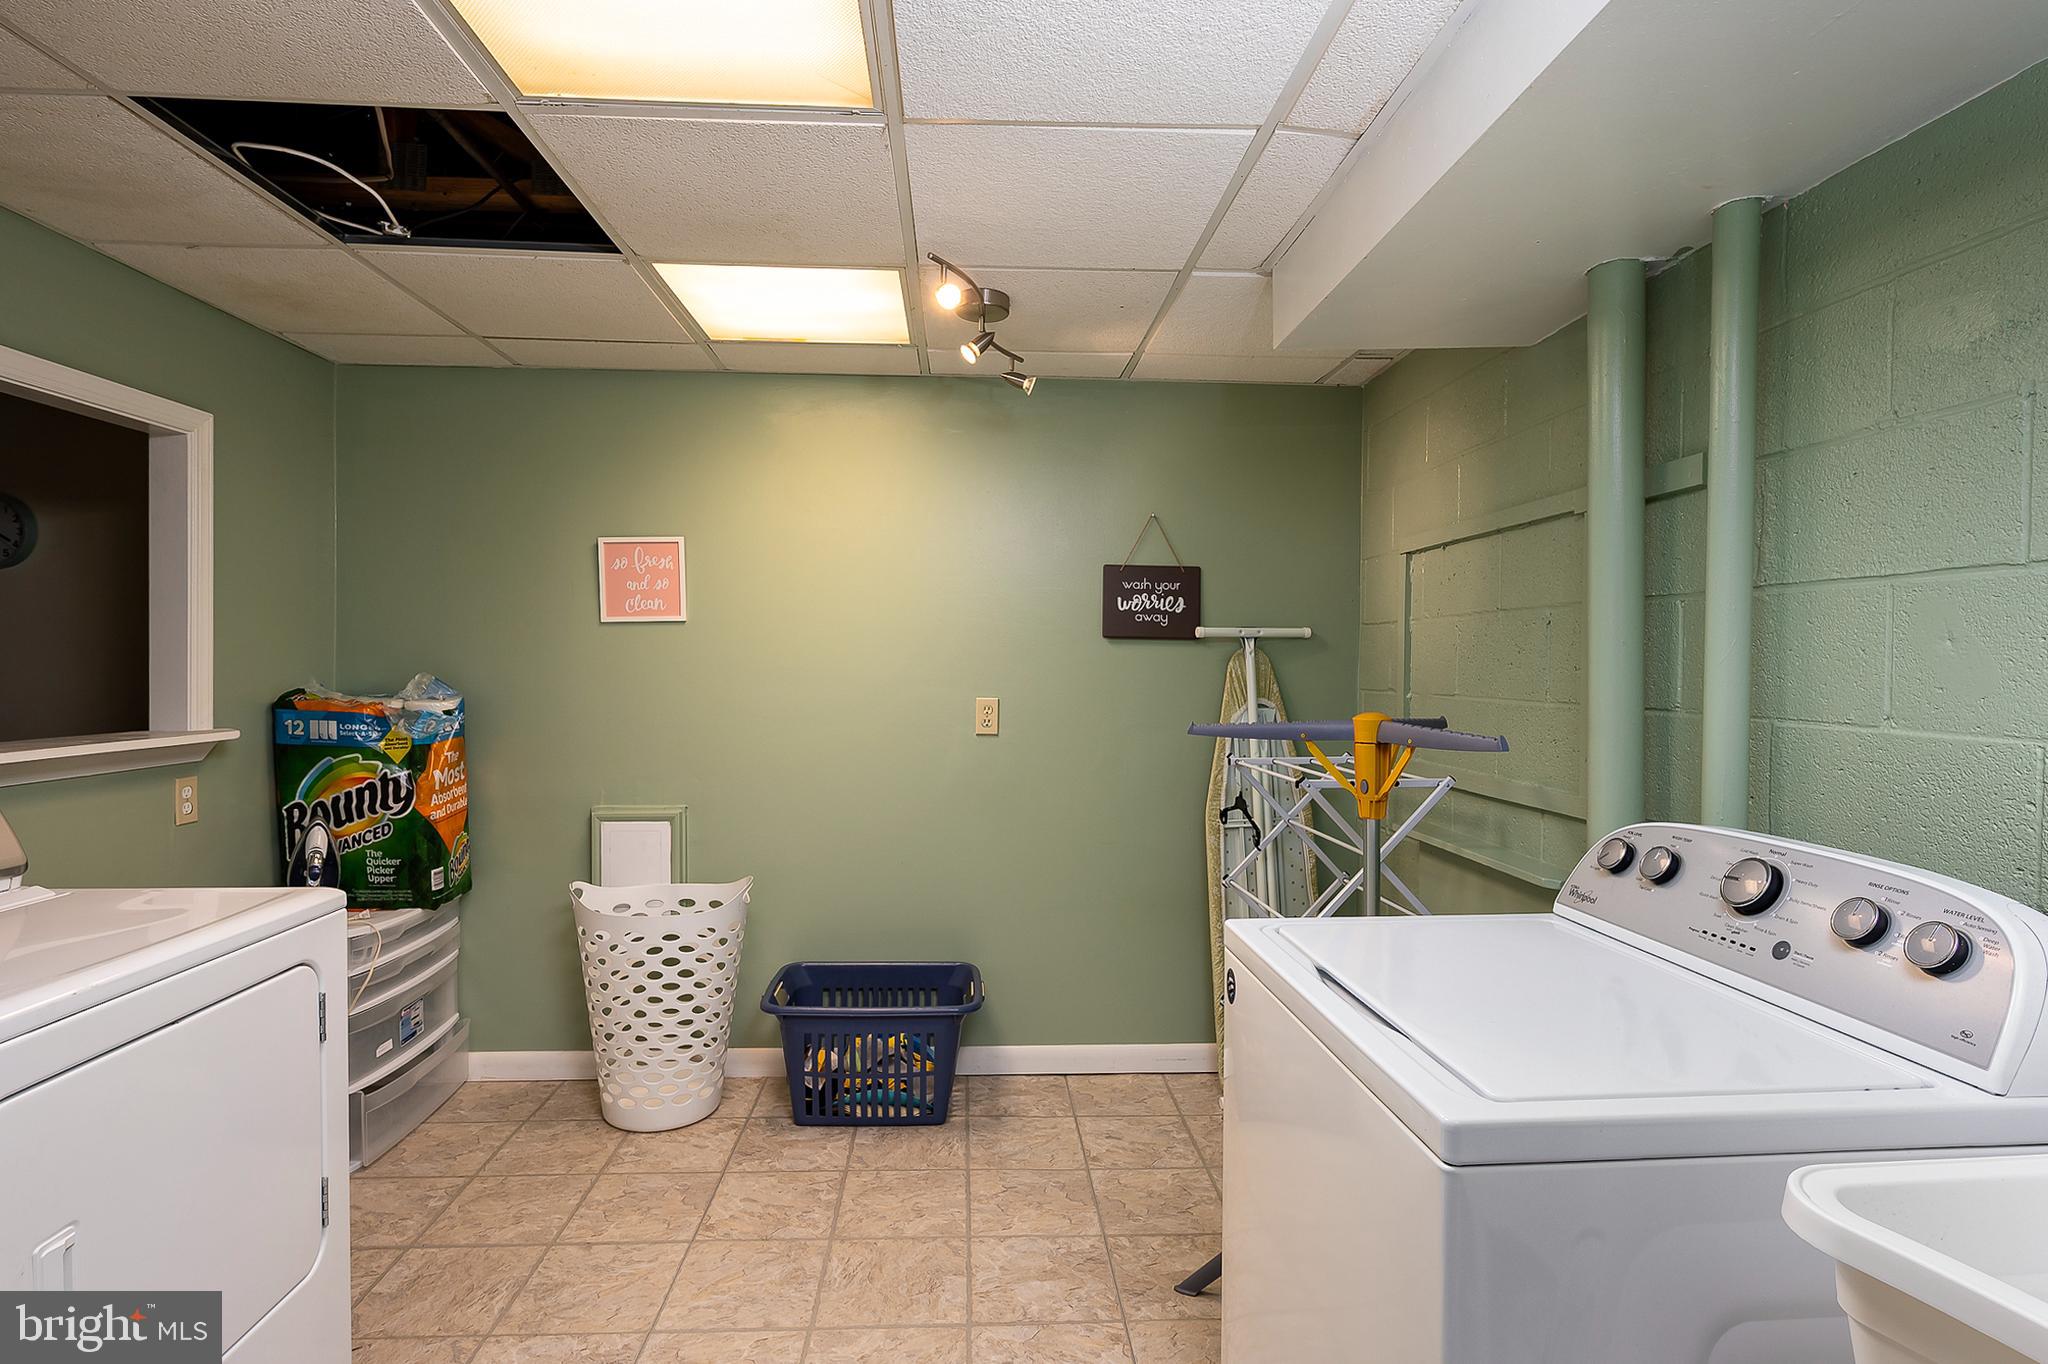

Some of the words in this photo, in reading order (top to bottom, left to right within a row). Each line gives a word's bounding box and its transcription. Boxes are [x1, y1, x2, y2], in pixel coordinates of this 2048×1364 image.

[2, 548, 10, 558] 5
[610, 556, 629, 570] so
[631, 546, 674, 574] fresh
[626, 574, 651, 591] and
[653, 577, 669, 591] so
[1122, 577, 1152, 590] wash
[1154, 582, 1181, 595] your
[625, 594, 667, 613] clean
[1117, 593, 1187, 613] worries
[1134, 613, 1168, 627] away
[284, 719, 305, 735] 12
[444, 751, 460, 763] The
[433, 761, 465, 790] Most
[431, 781, 468, 807] Absorbent
[430, 805, 446, 821] and
[364, 849, 383, 858] The
[1769, 848, 1788, 858] Normal
[366, 857, 402, 867] Quicker
[366, 866, 396, 875] Picker
[368, 874, 396, 884] Upper
[1568, 887, 1599, 904] Whirlpool
[1868, 881, 1885, 891] RINSE
[1884, 884, 1910, 896] OPTIONS
[1942, 907, 1965, 919] WATER
[1964, 912, 1986, 924] LEVEL
[1963, 921, 1978, 930] Auto
[1982, 936, 2000, 947] Deep
[1982, 943, 2001, 952] Water
